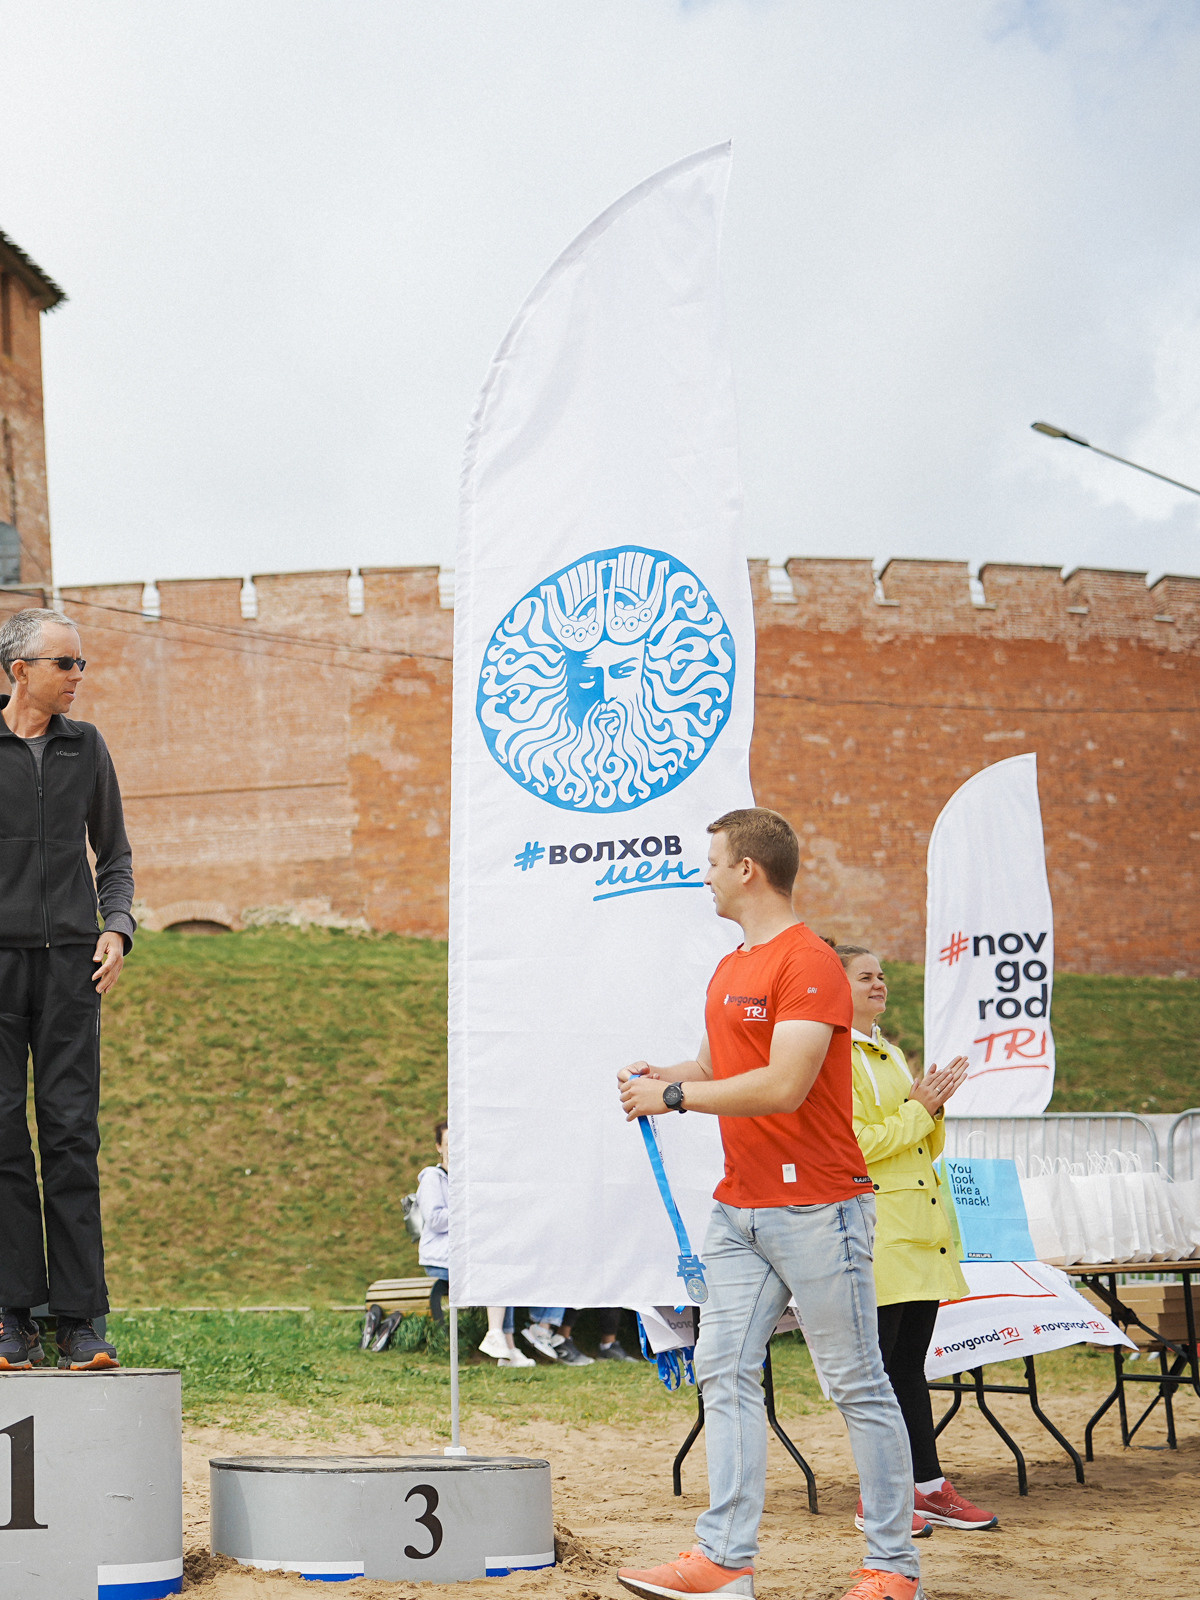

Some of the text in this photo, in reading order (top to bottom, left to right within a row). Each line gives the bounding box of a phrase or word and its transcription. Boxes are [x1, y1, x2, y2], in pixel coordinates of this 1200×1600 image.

[513, 834, 683, 872] #ВОЛХОВ
[939, 931, 1047, 966] #nov
[995, 959, 1048, 993] go
[744, 1006, 767, 1018] TRI
[978, 983, 1048, 1019] rod
[973, 1028, 1047, 1062] TRI
[948, 1163, 972, 1174] You
[950, 1173, 975, 1185] look
[952, 1183, 981, 1196] like a
[955, 1195, 990, 1207] snack!
[403, 1483, 444, 1560] 3
